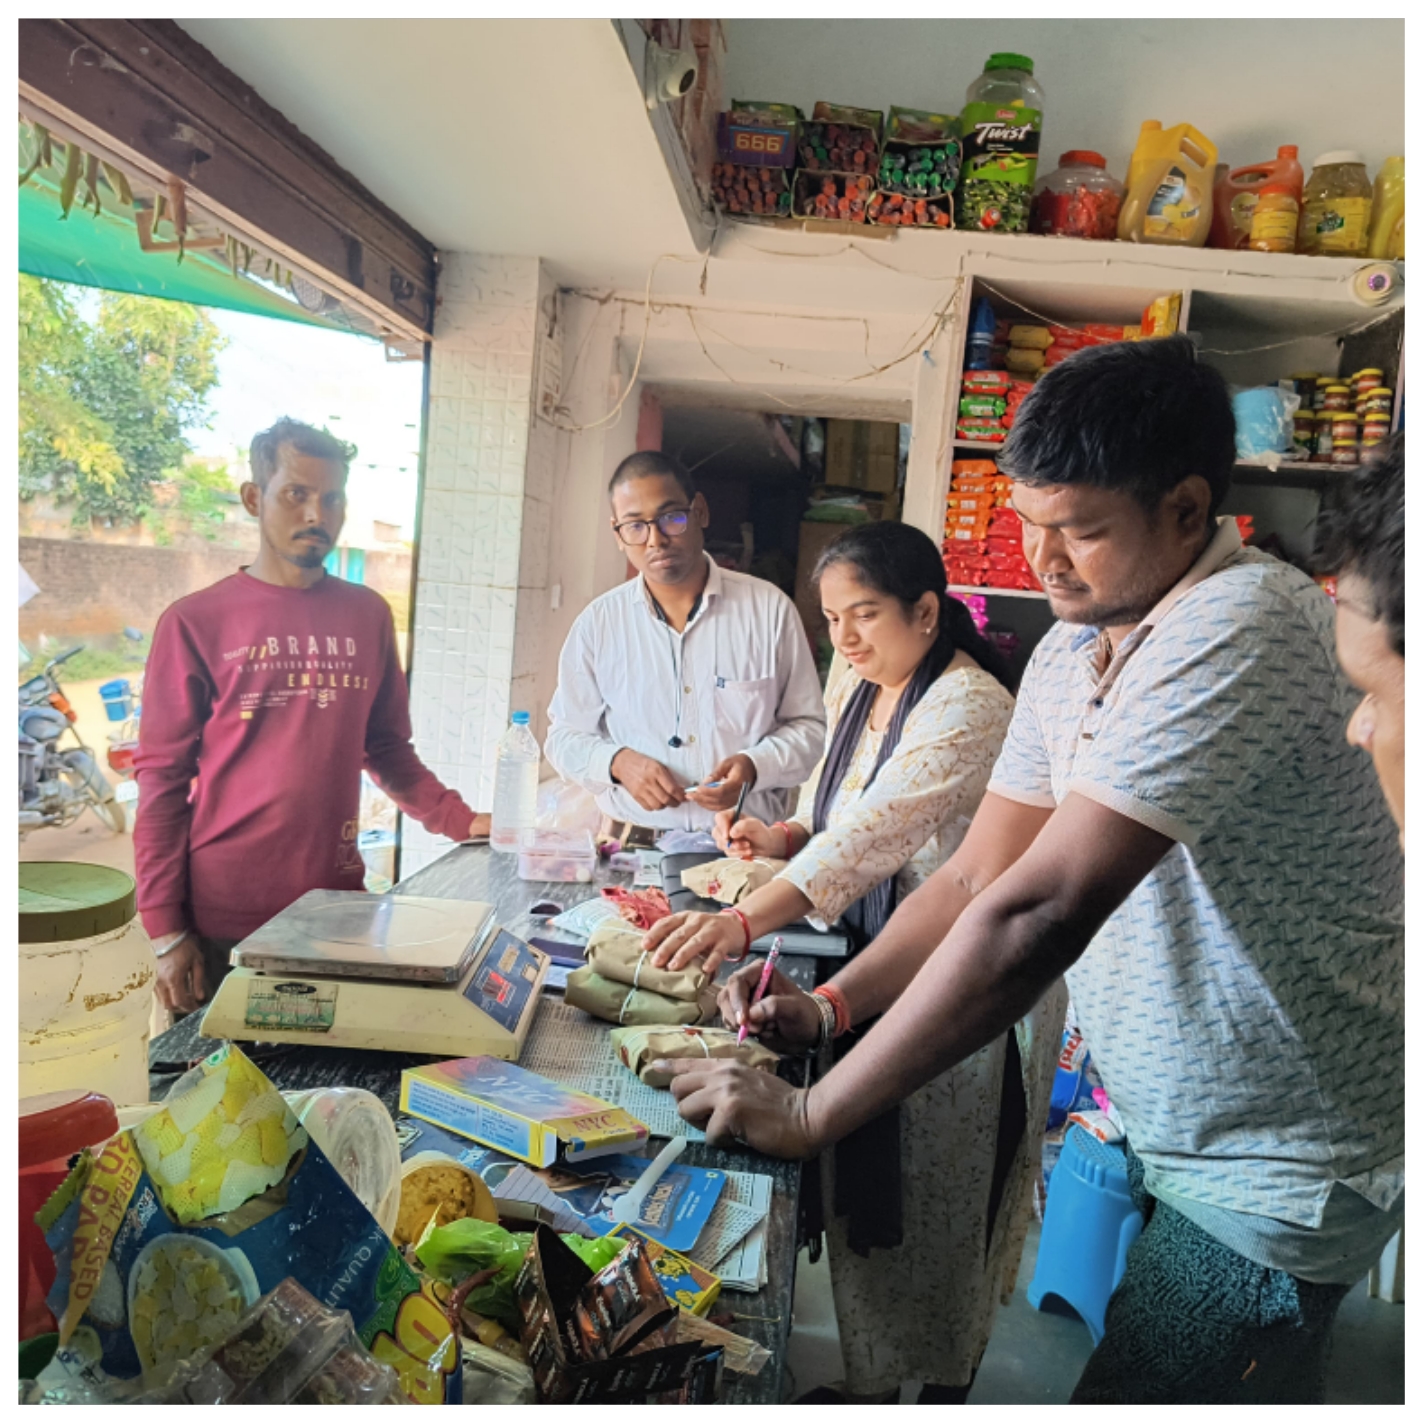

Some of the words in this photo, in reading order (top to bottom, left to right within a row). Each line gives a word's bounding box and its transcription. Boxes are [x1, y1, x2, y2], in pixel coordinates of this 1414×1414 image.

[735, 133, 781, 153] 666
[974, 121, 1033, 145] Twist
[266, 635, 357, 657] BRAND
[477, 1074, 558, 1104] NYC
[573, 1113, 619, 1133] NYC
[107, 1156, 141, 1223] CEREAL
[73, 1223, 113, 1301] BASED
[325, 1246, 372, 1308] QUALIT
